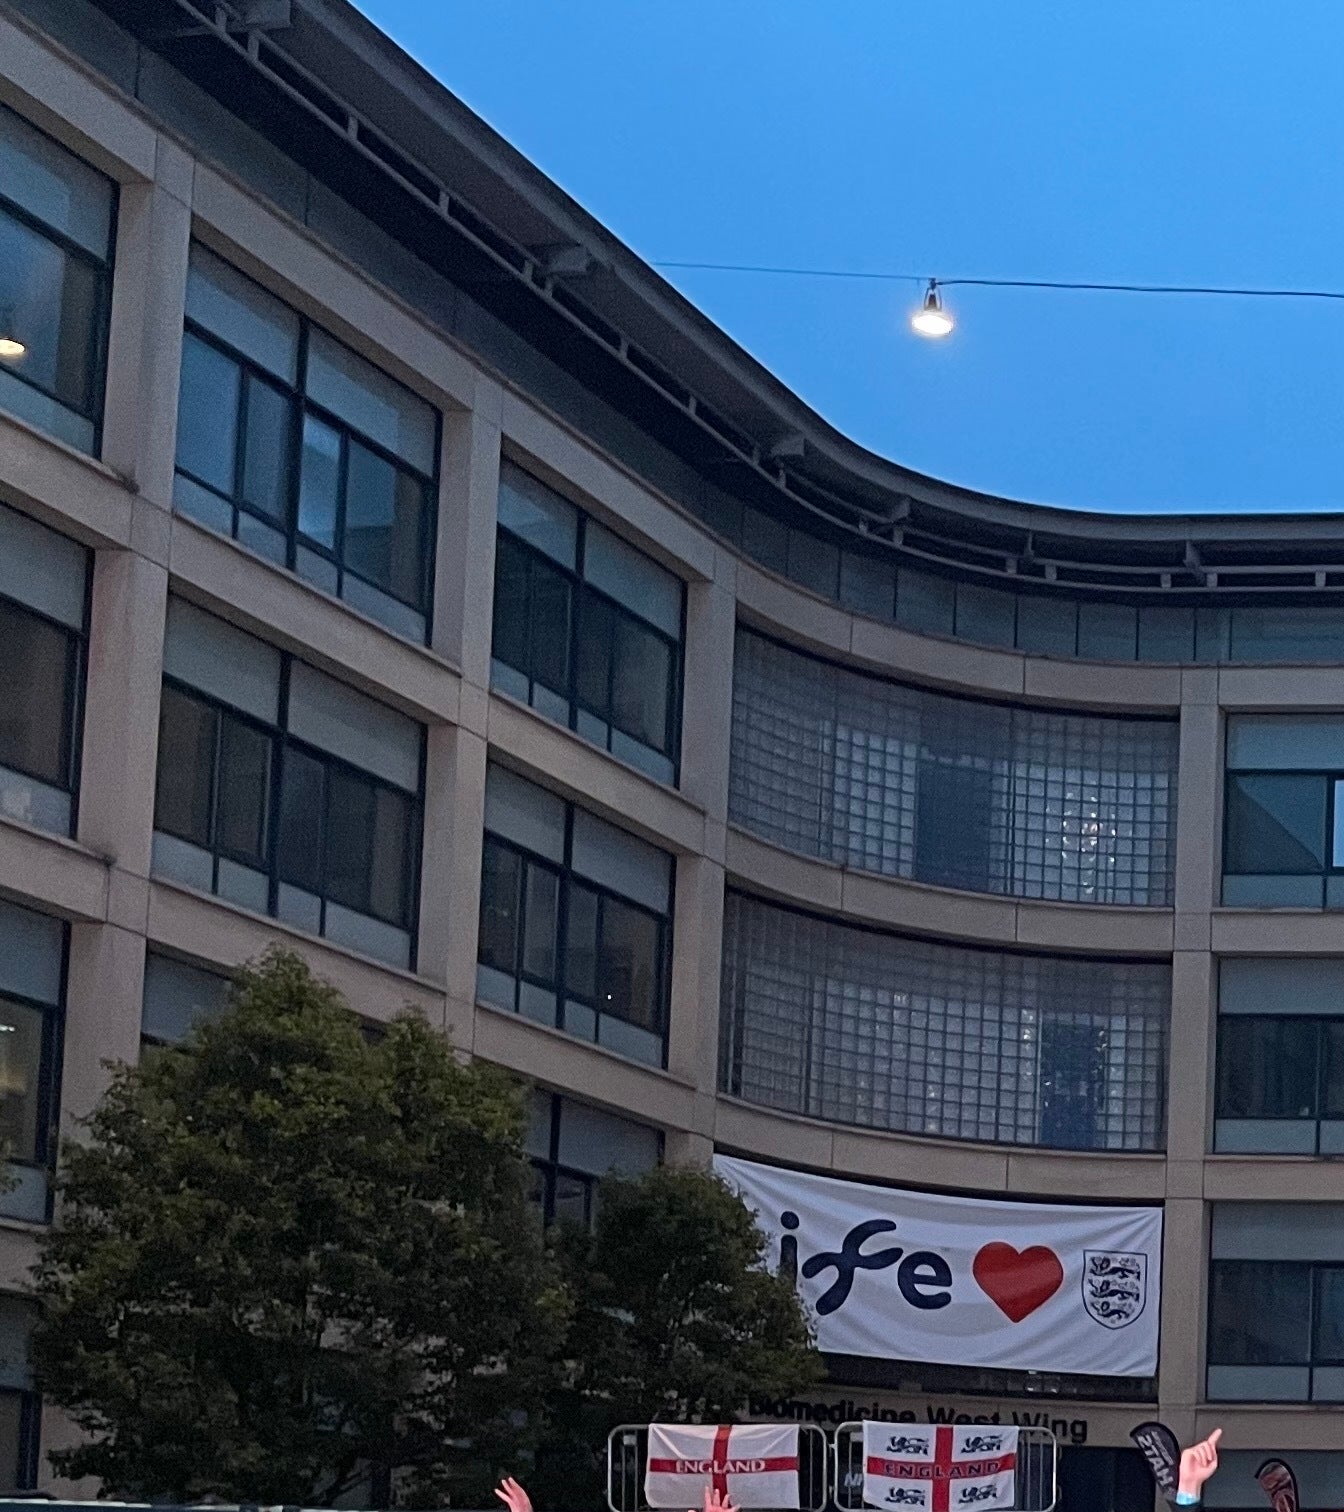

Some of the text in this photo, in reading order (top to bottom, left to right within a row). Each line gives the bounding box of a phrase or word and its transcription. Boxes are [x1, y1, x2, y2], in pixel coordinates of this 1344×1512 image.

[779, 1210, 953, 1316] ife
[1012, 1411, 1088, 1444] Wing
[675, 1459, 766, 1474] ENGLAND
[885, 1462, 1000, 1478] ENGLAND
